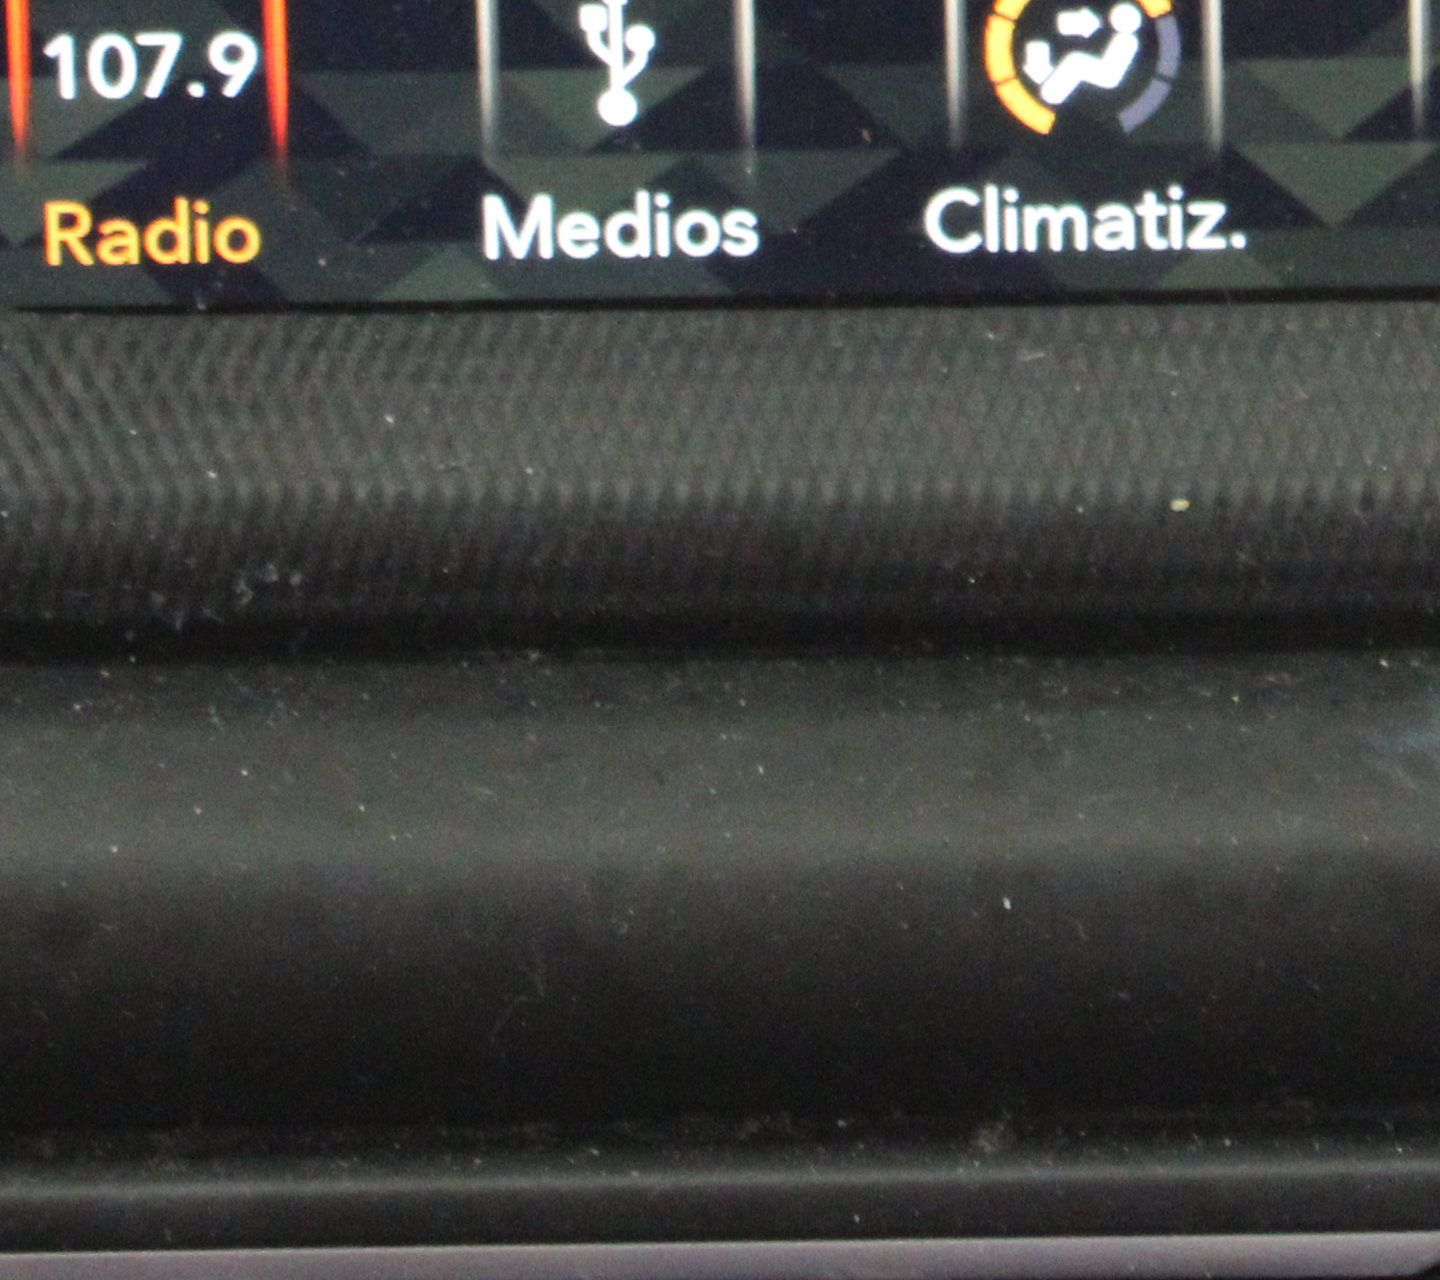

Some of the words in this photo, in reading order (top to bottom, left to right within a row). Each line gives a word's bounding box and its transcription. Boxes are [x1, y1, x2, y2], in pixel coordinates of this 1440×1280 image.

[40, 30, 260, 104] 107.9
[42, 196, 261, 267] Radio
[482, 188, 761, 261] Medios
[923, 183, 1248, 255] Climatiz.
